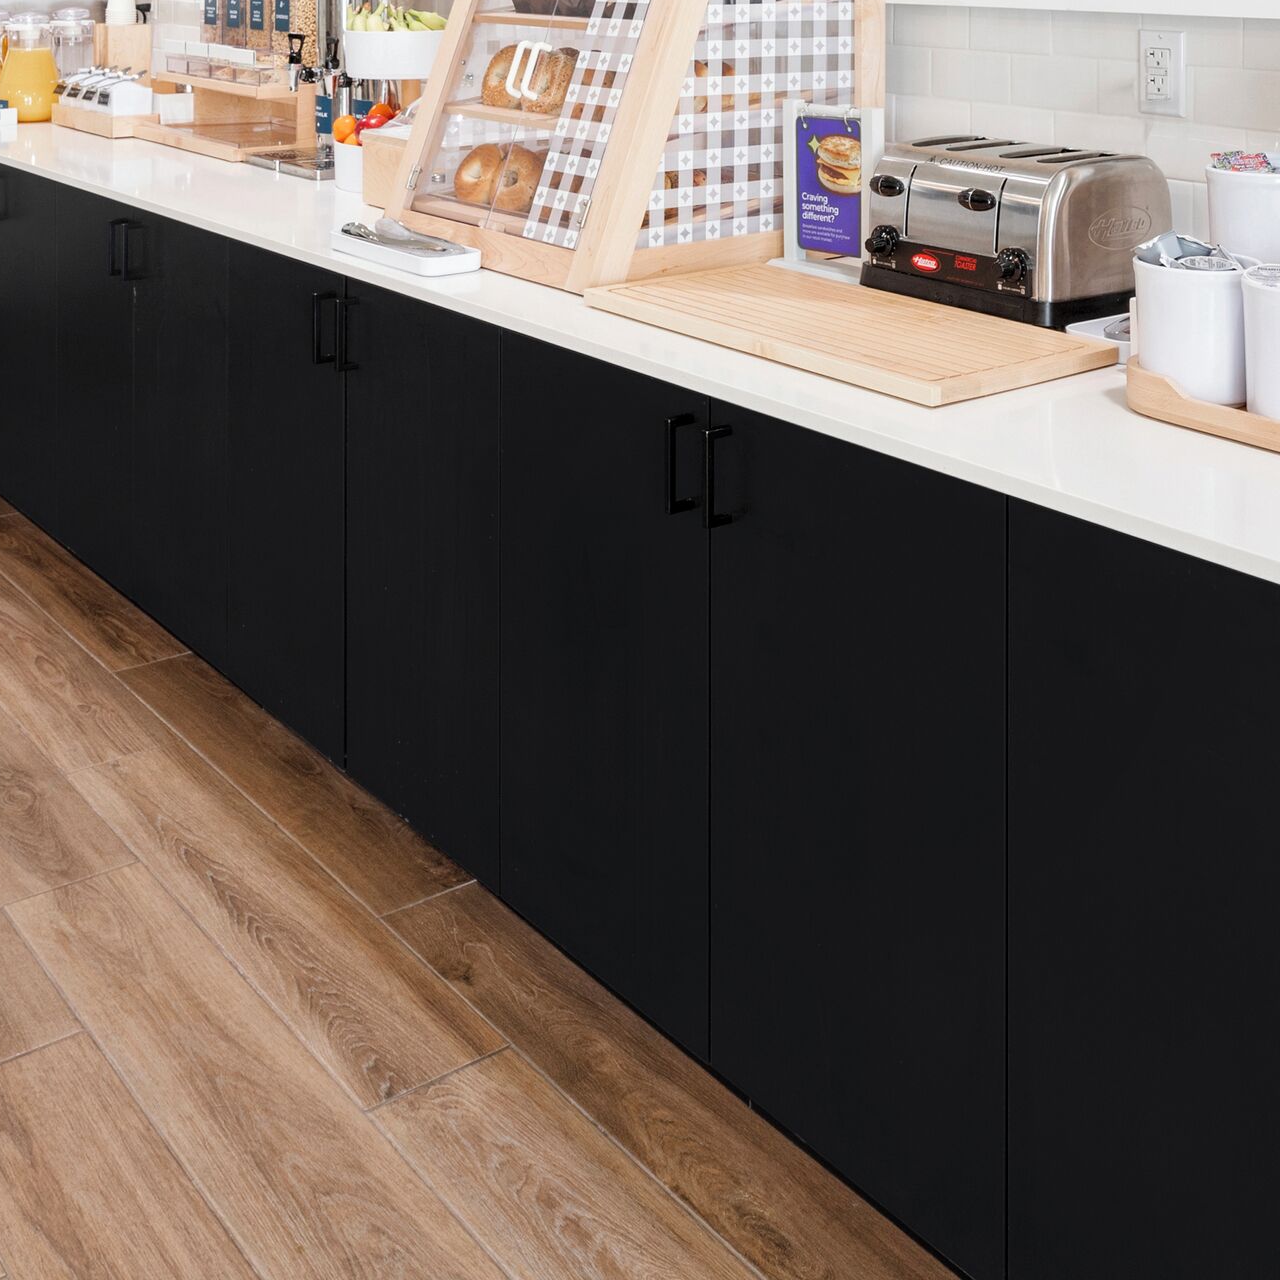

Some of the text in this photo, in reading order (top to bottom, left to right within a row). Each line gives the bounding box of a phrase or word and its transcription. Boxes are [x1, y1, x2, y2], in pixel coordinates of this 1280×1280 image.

[802, 192, 828, 205] Craving
[801, 203, 839, 216] something
[802, 211, 835, 223] different?
